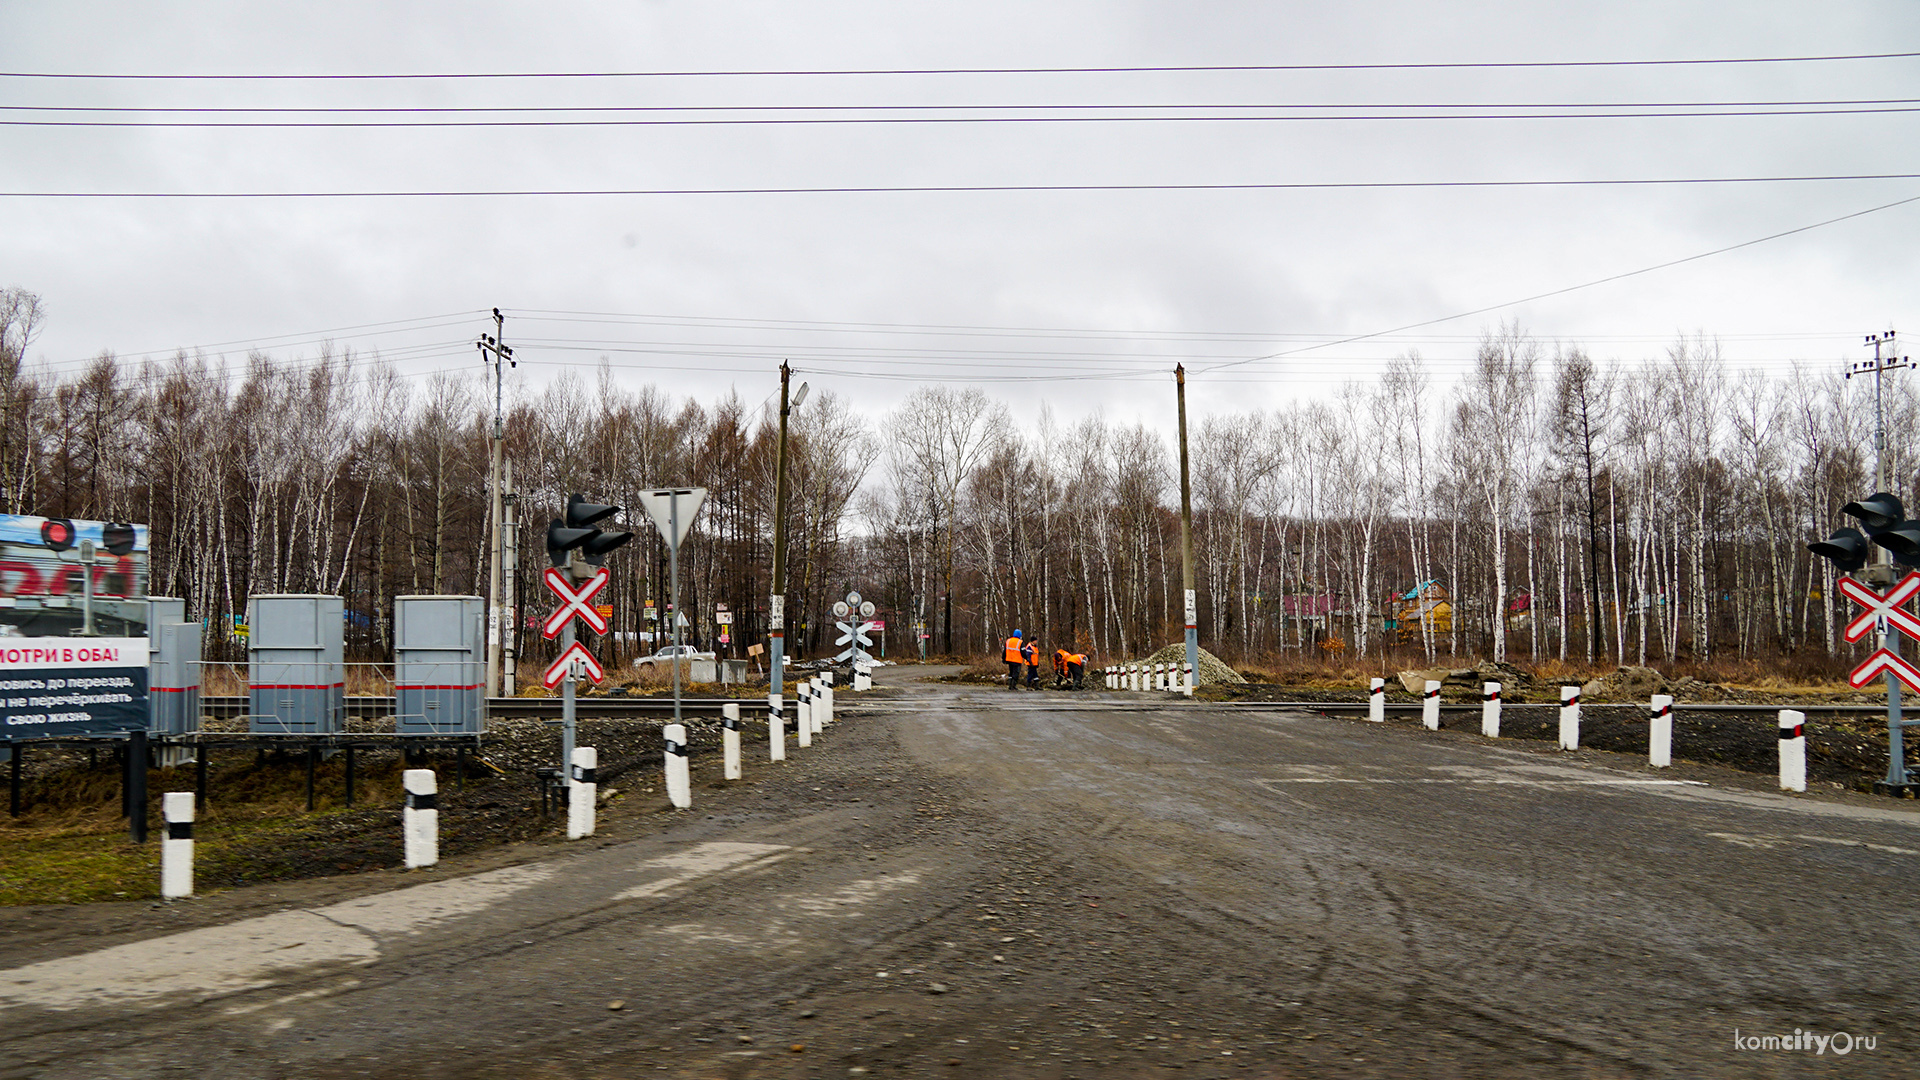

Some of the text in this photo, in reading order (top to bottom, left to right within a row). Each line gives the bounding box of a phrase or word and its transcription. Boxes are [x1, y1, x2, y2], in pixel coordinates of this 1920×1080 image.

[62, 649, 73, 661] В
[77, 648, 119, 662] ОБА!
[0, 677, 134, 690] овись до переезда,
[7, 697, 27, 707] не
[28, 692, 132, 708] перечёркивать
[6, 712, 92, 725] свою жизнь
